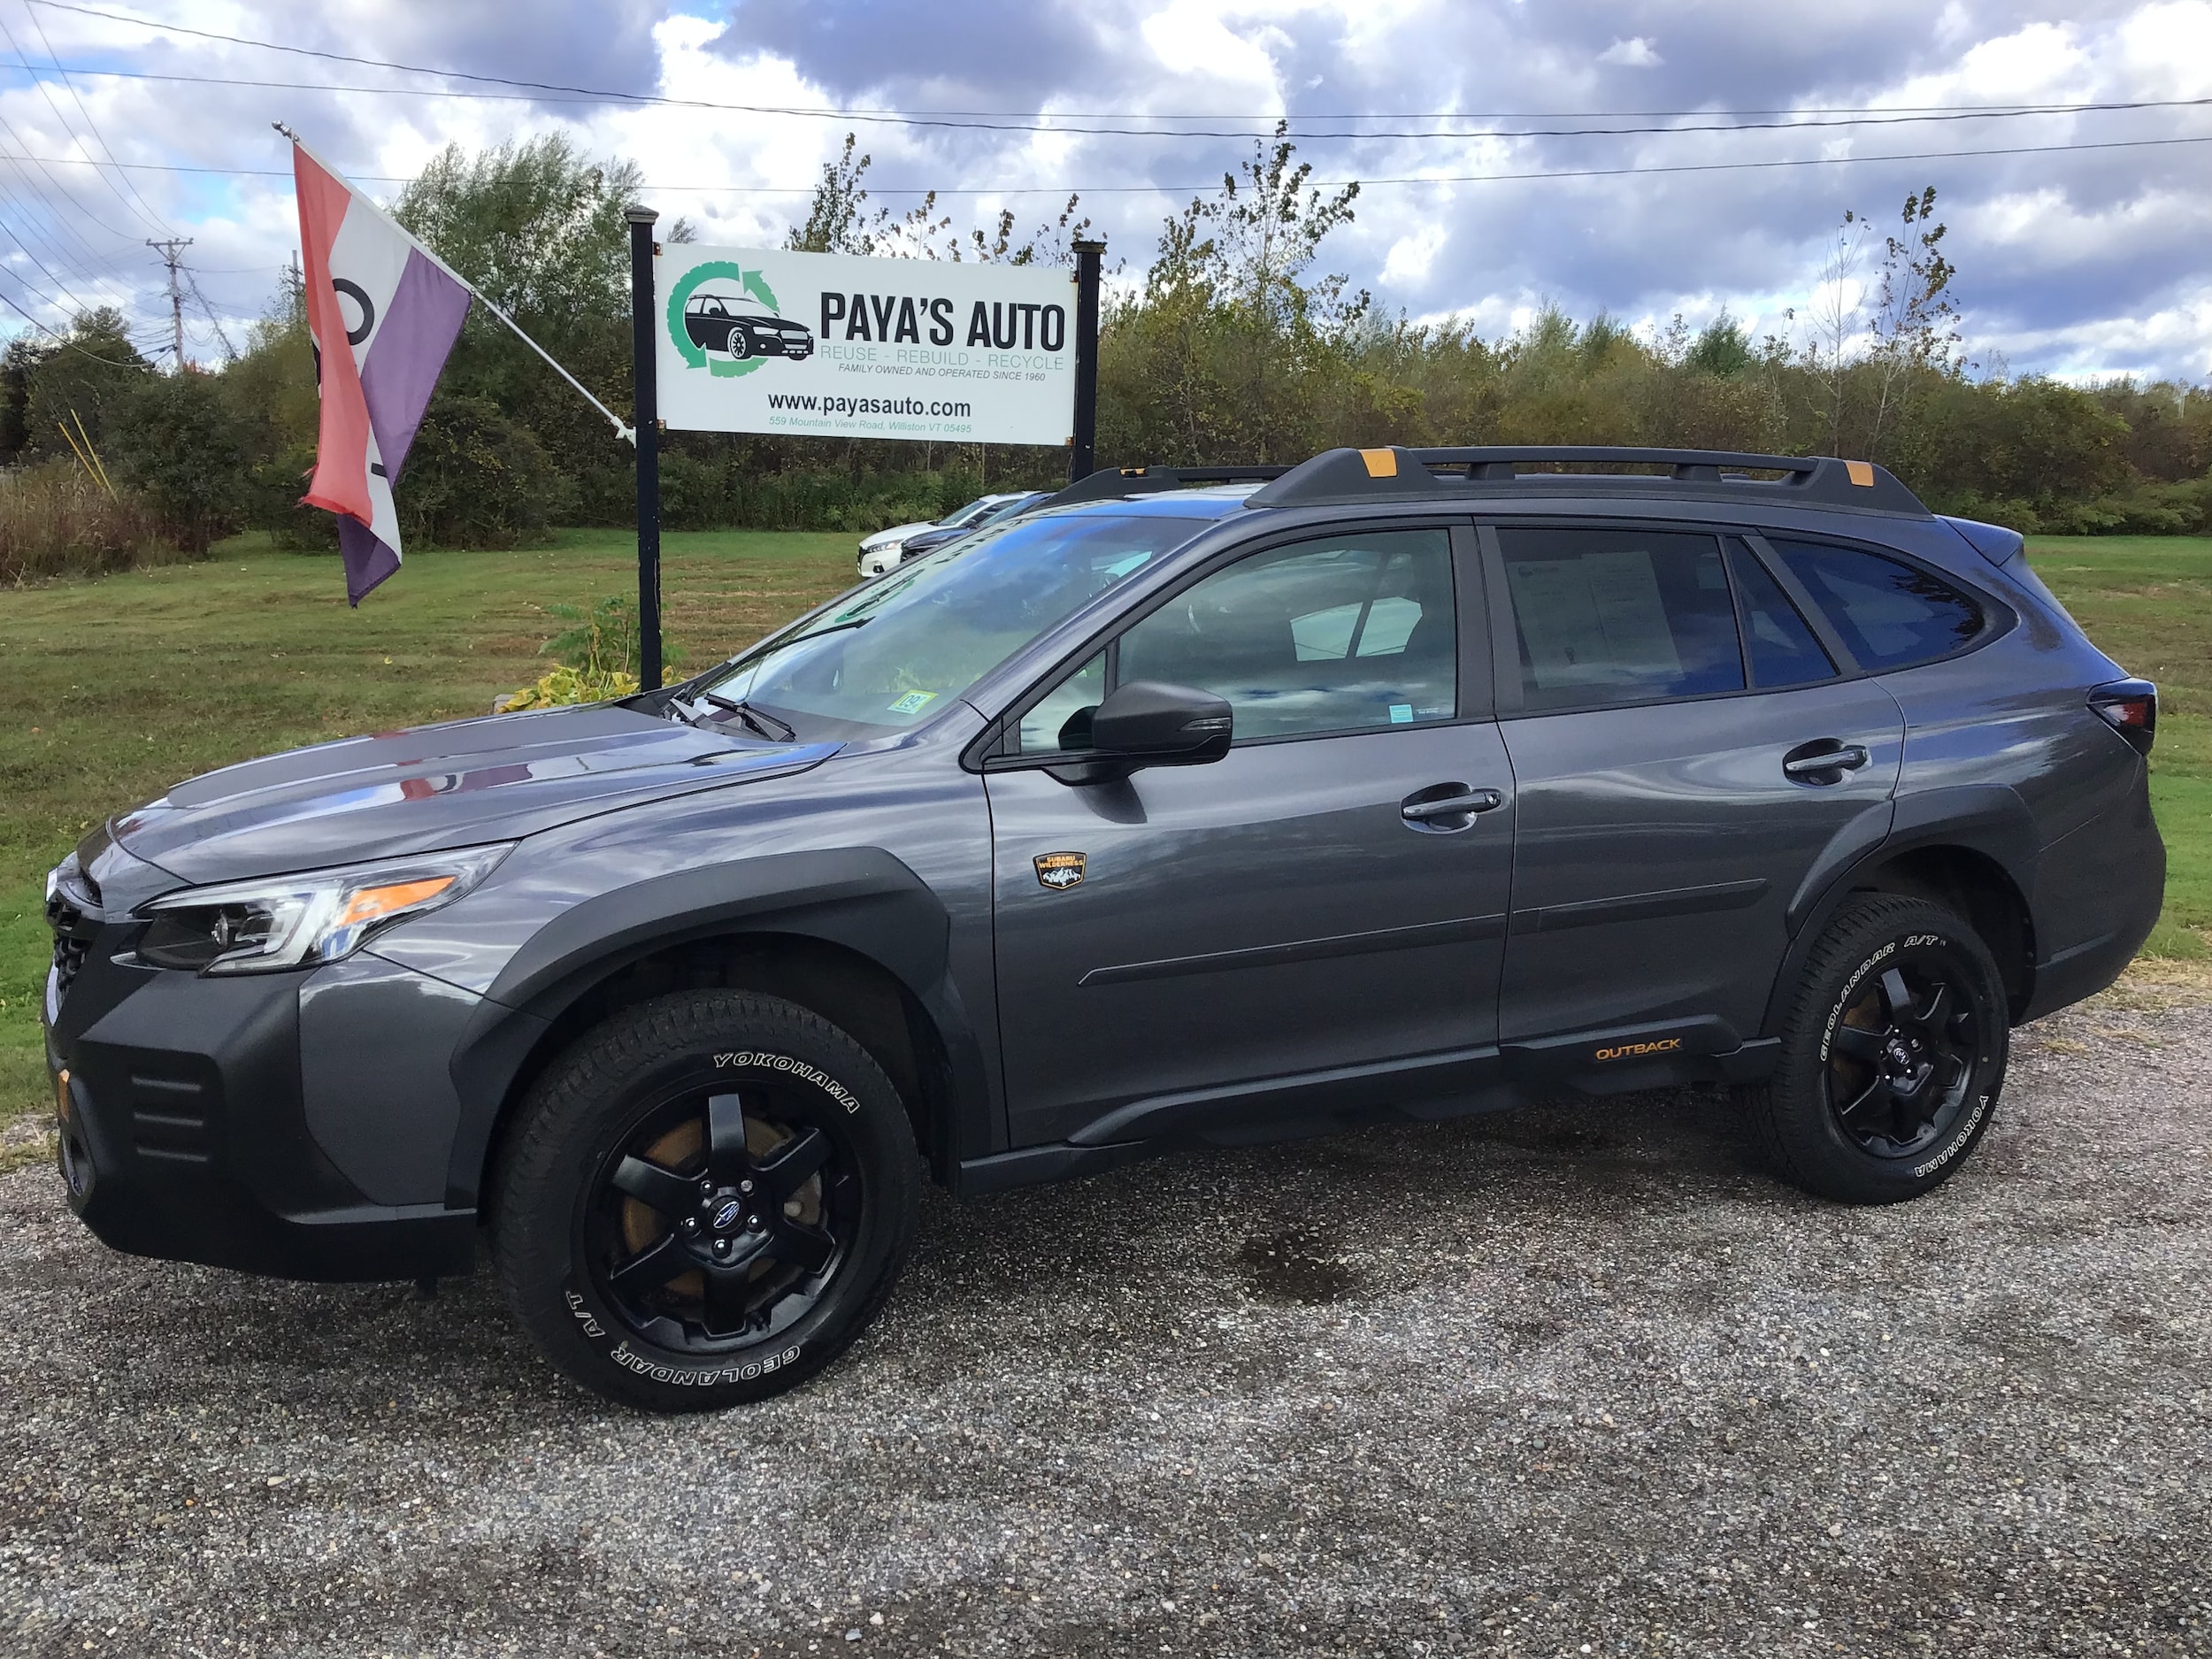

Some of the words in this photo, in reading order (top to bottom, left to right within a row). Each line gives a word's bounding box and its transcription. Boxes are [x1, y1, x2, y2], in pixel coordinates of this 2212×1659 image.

[820, 291, 954, 347] PAYA'S
[966, 301, 1065, 352] AUTO
[820, 345, 878, 361] REUSE
[897, 349, 969, 366] REBUILD
[988, 354, 1064, 371] RECYCLE
[838, 363, 873, 373] FAMILY
[875, 365, 913, 376] OWNED
[914, 367, 936, 377] AND
[938, 368, 991, 380] OPERATED
[992, 371, 1022, 380] SINCE
[1025, 373, 1046, 381] 1960
[767, 394, 972, 418] www.payasauto.com
[769, 416, 787, 426] 559
[788, 417, 832, 428] Mountain
[834, 419, 857, 429] View
[858, 419, 886, 431] Road,
[888, 421, 926, 432] Williston
[928, 423, 941, 432] VT
[943, 424, 972, 433] 05495
[1820, 942, 1895, 1062] GEOLANDAR
[1903, 935, 1939, 948] A/T
[1595, 1038, 1681, 1061] OUTBACK
[713, 1051, 860, 1113] YOKOHAMA
[1914, 1094, 1990, 1178] YOKOHAMA
[565, 1290, 606, 1338] A/T
[611, 1345, 801, 1386] GEOLANDAR
